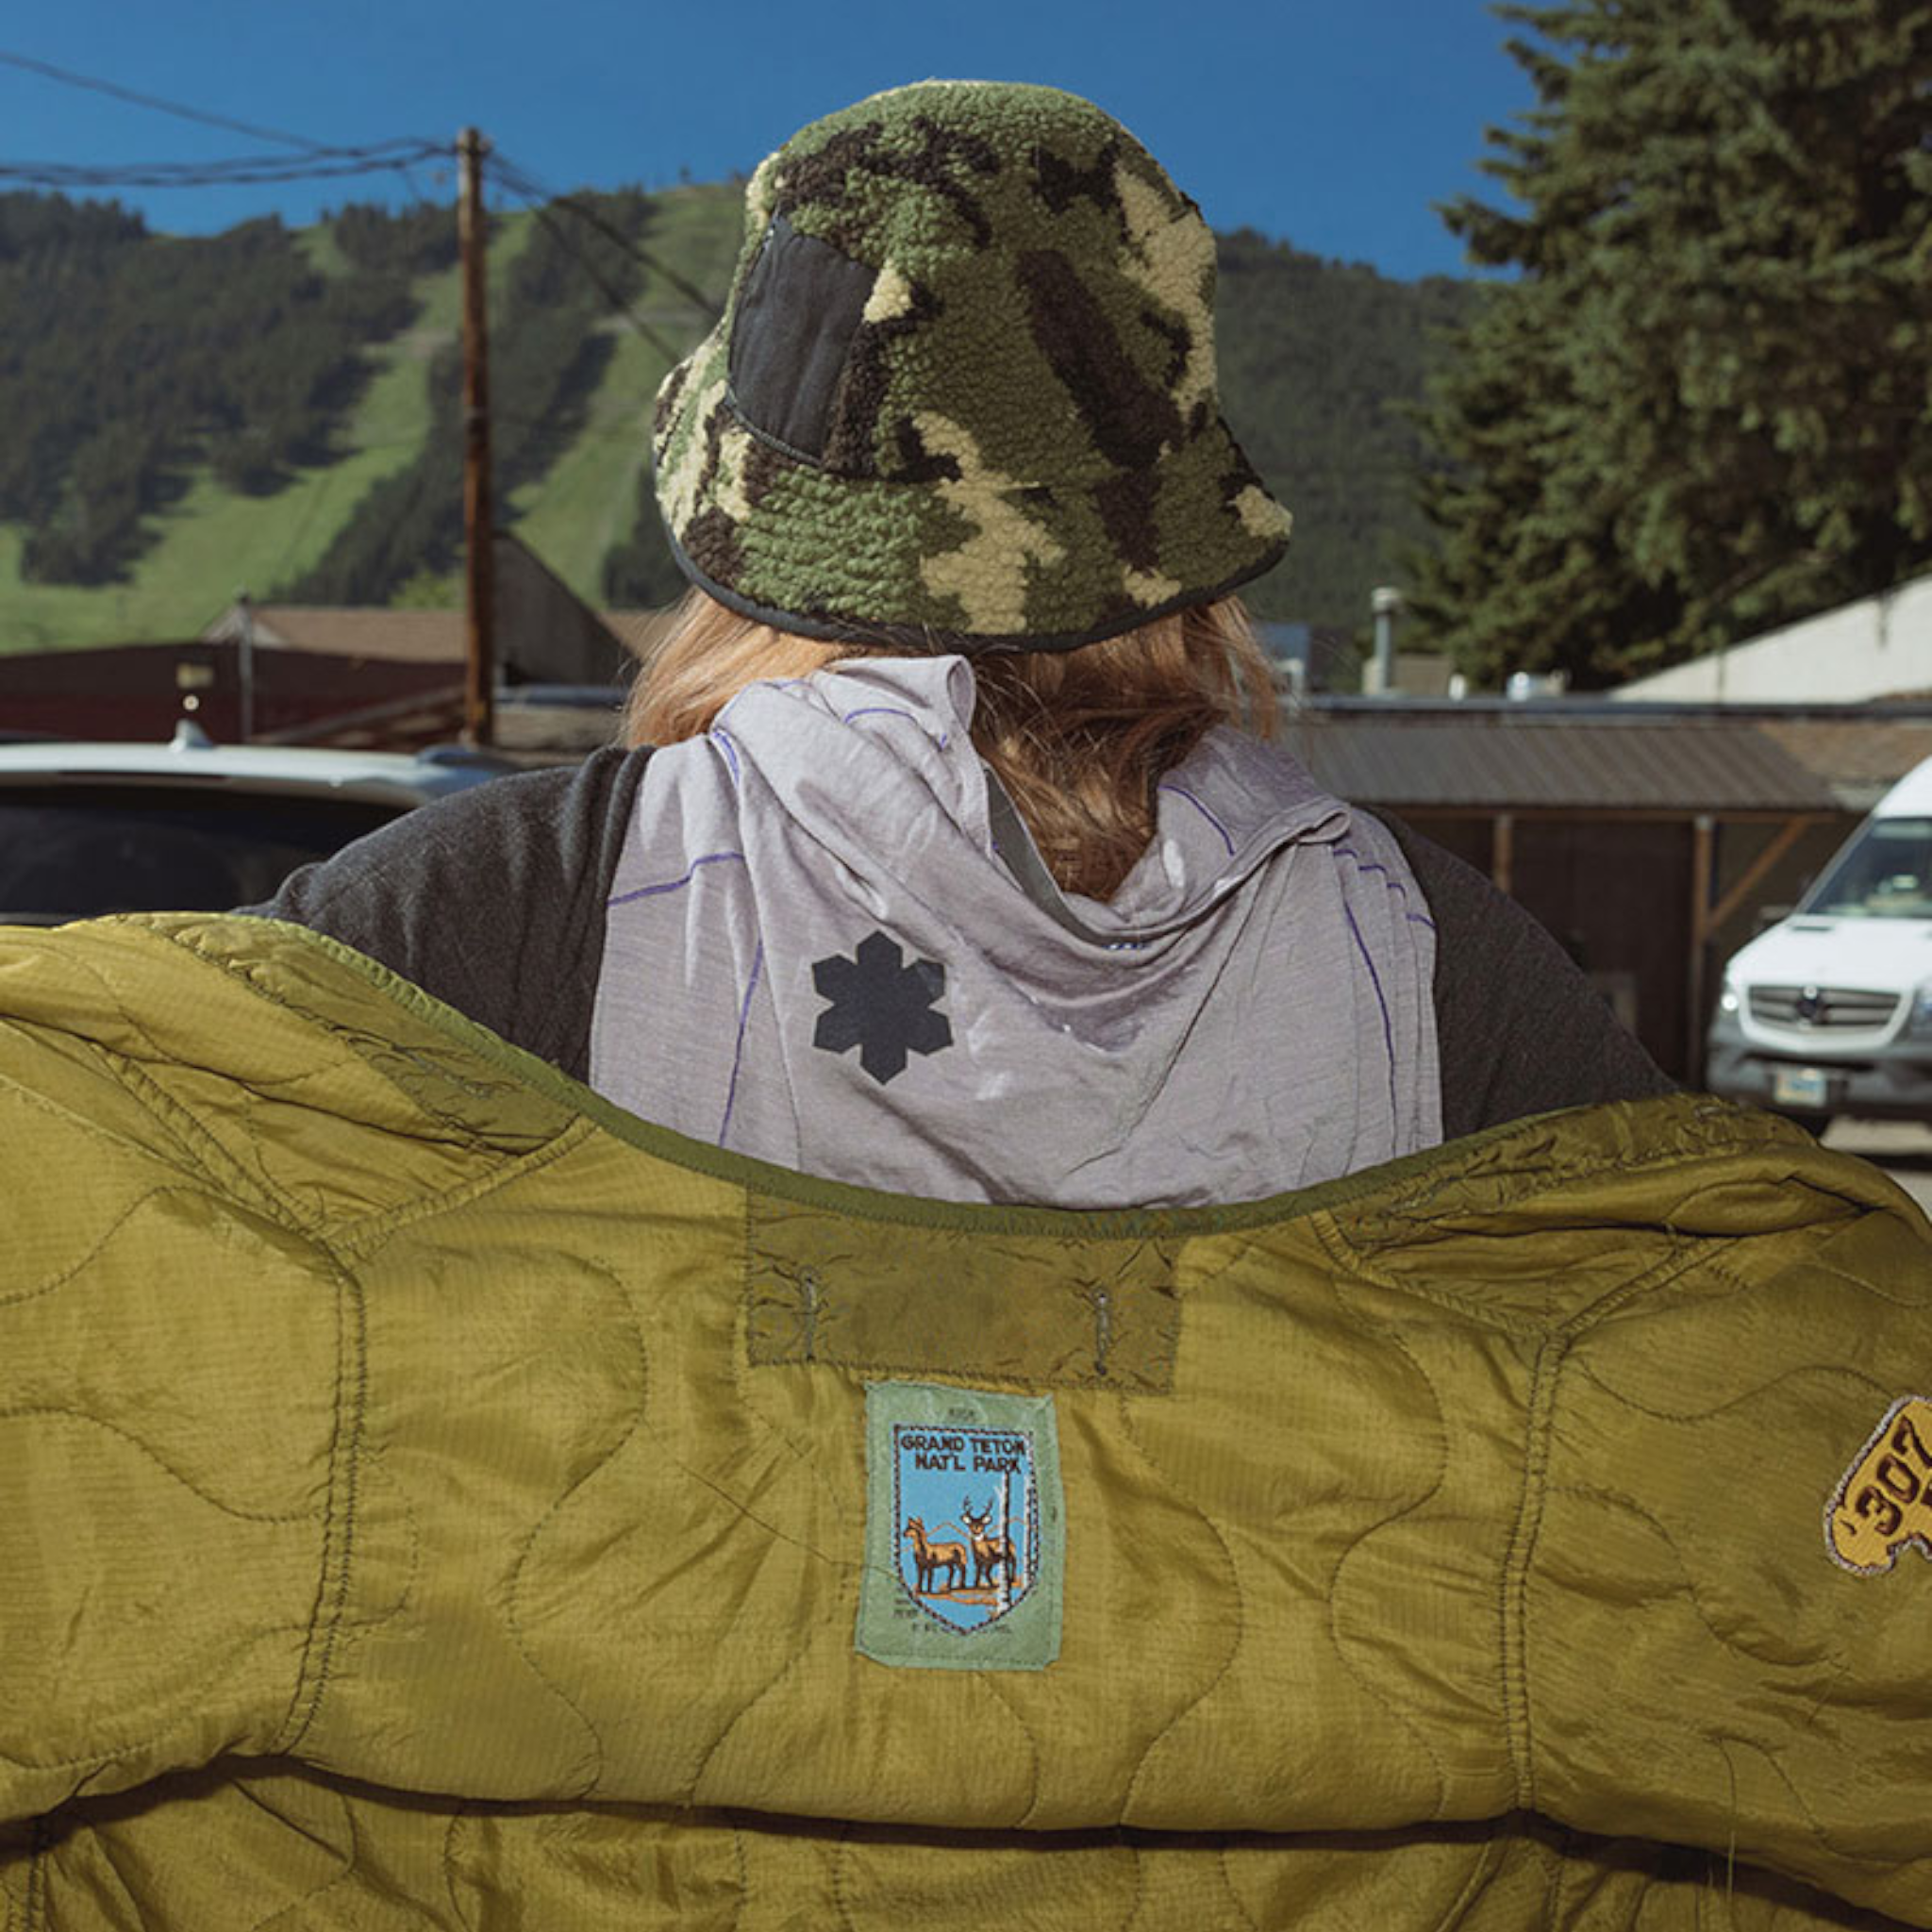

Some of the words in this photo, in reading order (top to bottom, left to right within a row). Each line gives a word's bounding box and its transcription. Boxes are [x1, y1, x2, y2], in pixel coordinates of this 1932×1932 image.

[901, 1435, 964, 1451] GRAND
[970, 1438, 1025, 1455] TETON
[974, 1456, 1022, 1474] PARK
[1856, 1415, 1932, 1537] 307
